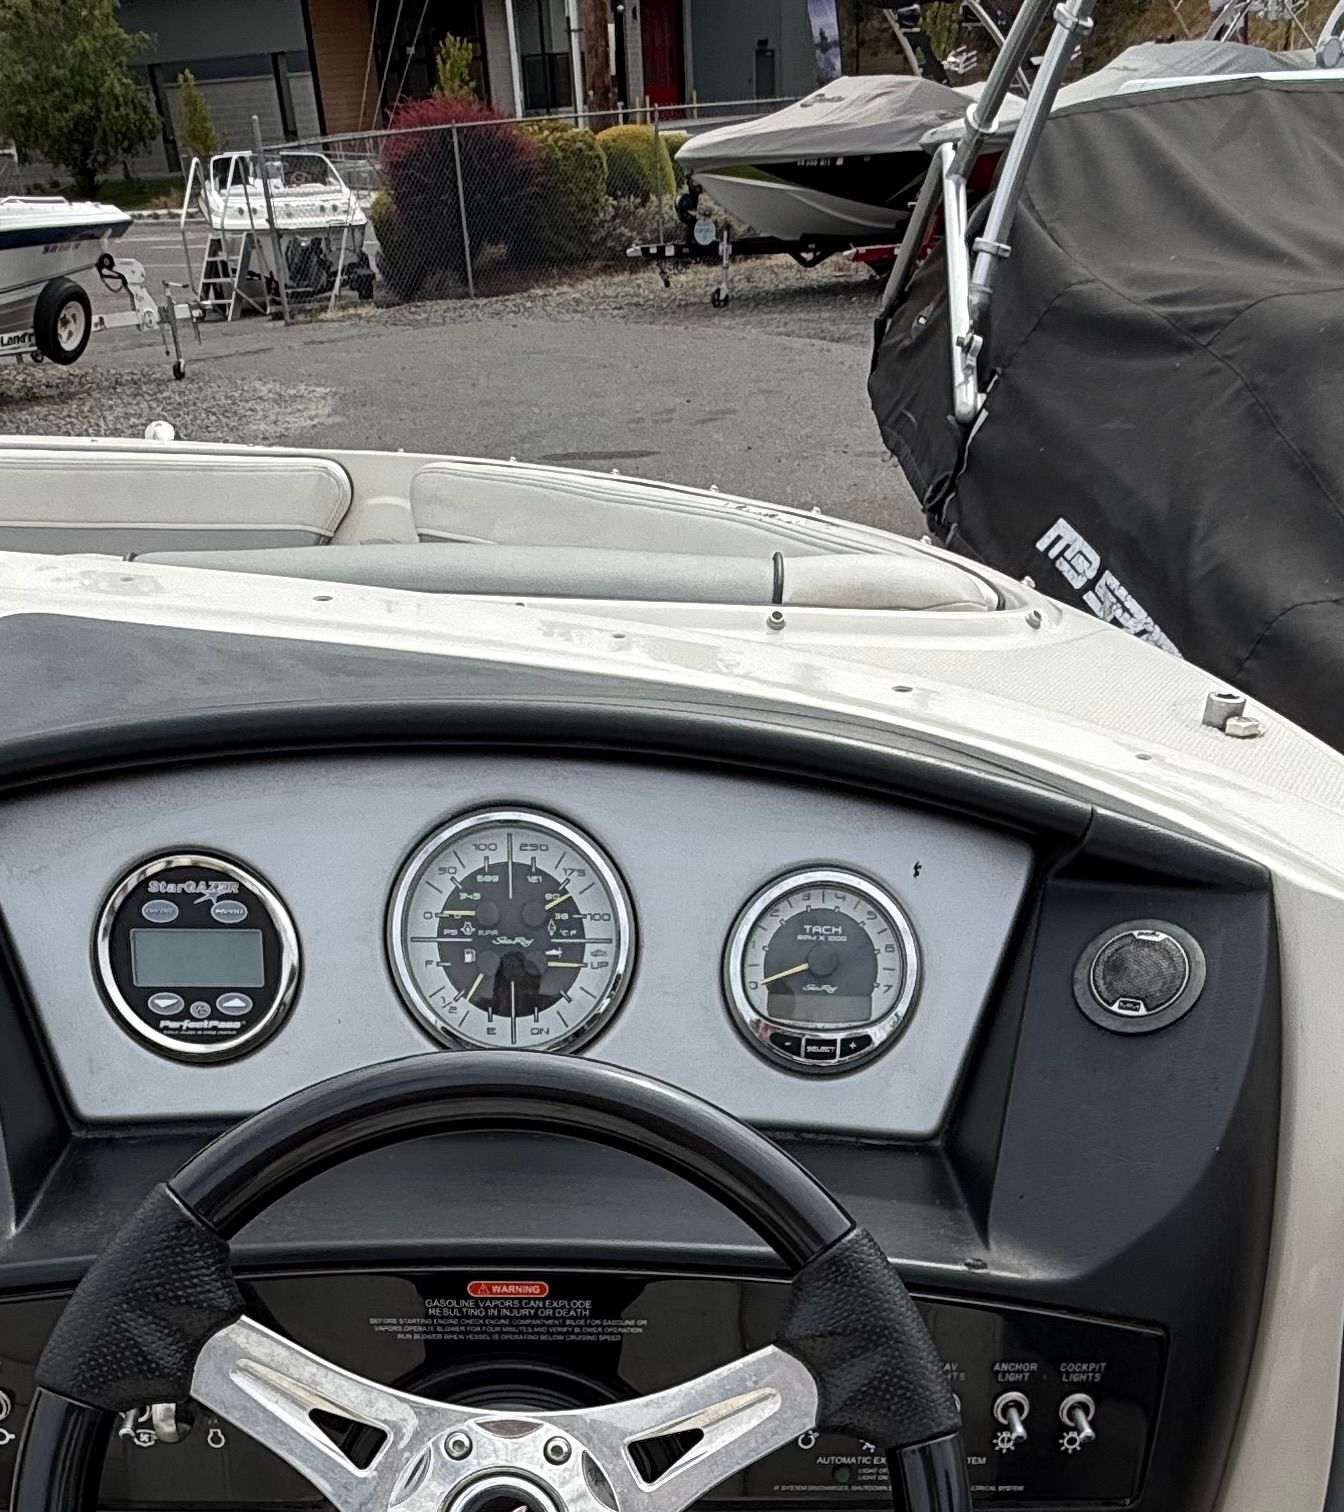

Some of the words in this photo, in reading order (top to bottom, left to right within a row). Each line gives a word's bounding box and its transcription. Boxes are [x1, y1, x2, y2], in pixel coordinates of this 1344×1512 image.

[472, 843, 498, 852] 100
[438, 866, 457, 876] 50
[147, 880, 240, 894] StarGAZER
[587, 913, 611, 921] 100
[866, 910, 877, 920] 5
[803, 924, 842, 934] TACH
[884, 943, 896, 953] 6
[589, 961, 609, 969] UP
[882, 985, 894, 994] 7
[159, 1019, 242, 1030] PerfectPass
[486, 1027, 497, 1035] E
[491, 1285, 540, 1294] WARNING
[425, 1299, 476, 1308] GASOLINE
[479, 1299, 520, 1308] VAPORS
[522, 1299, 544, 1308] CAN
[545, 1299, 592, 1309] EXPLODE
[428, 1308, 486, 1317] RESULTING
[487, 1308, 498, 1317] IN
[500, 1308, 536, 1317] INJURY
[537, 1308, 554, 1317] OR
[555, 1308, 590, 1317] DEATH
[942, 1362, 959, 1372] AV
[993, 1362, 1039, 1372] ANCHOR
[1060, 1362, 1107, 1372] COCKPIT
[997, 1373, 1031, 1382] LIGHT
[1062, 1373, 1102, 1383] LIGHTS
[816, 1456, 873, 1465] AUTOMATIC
